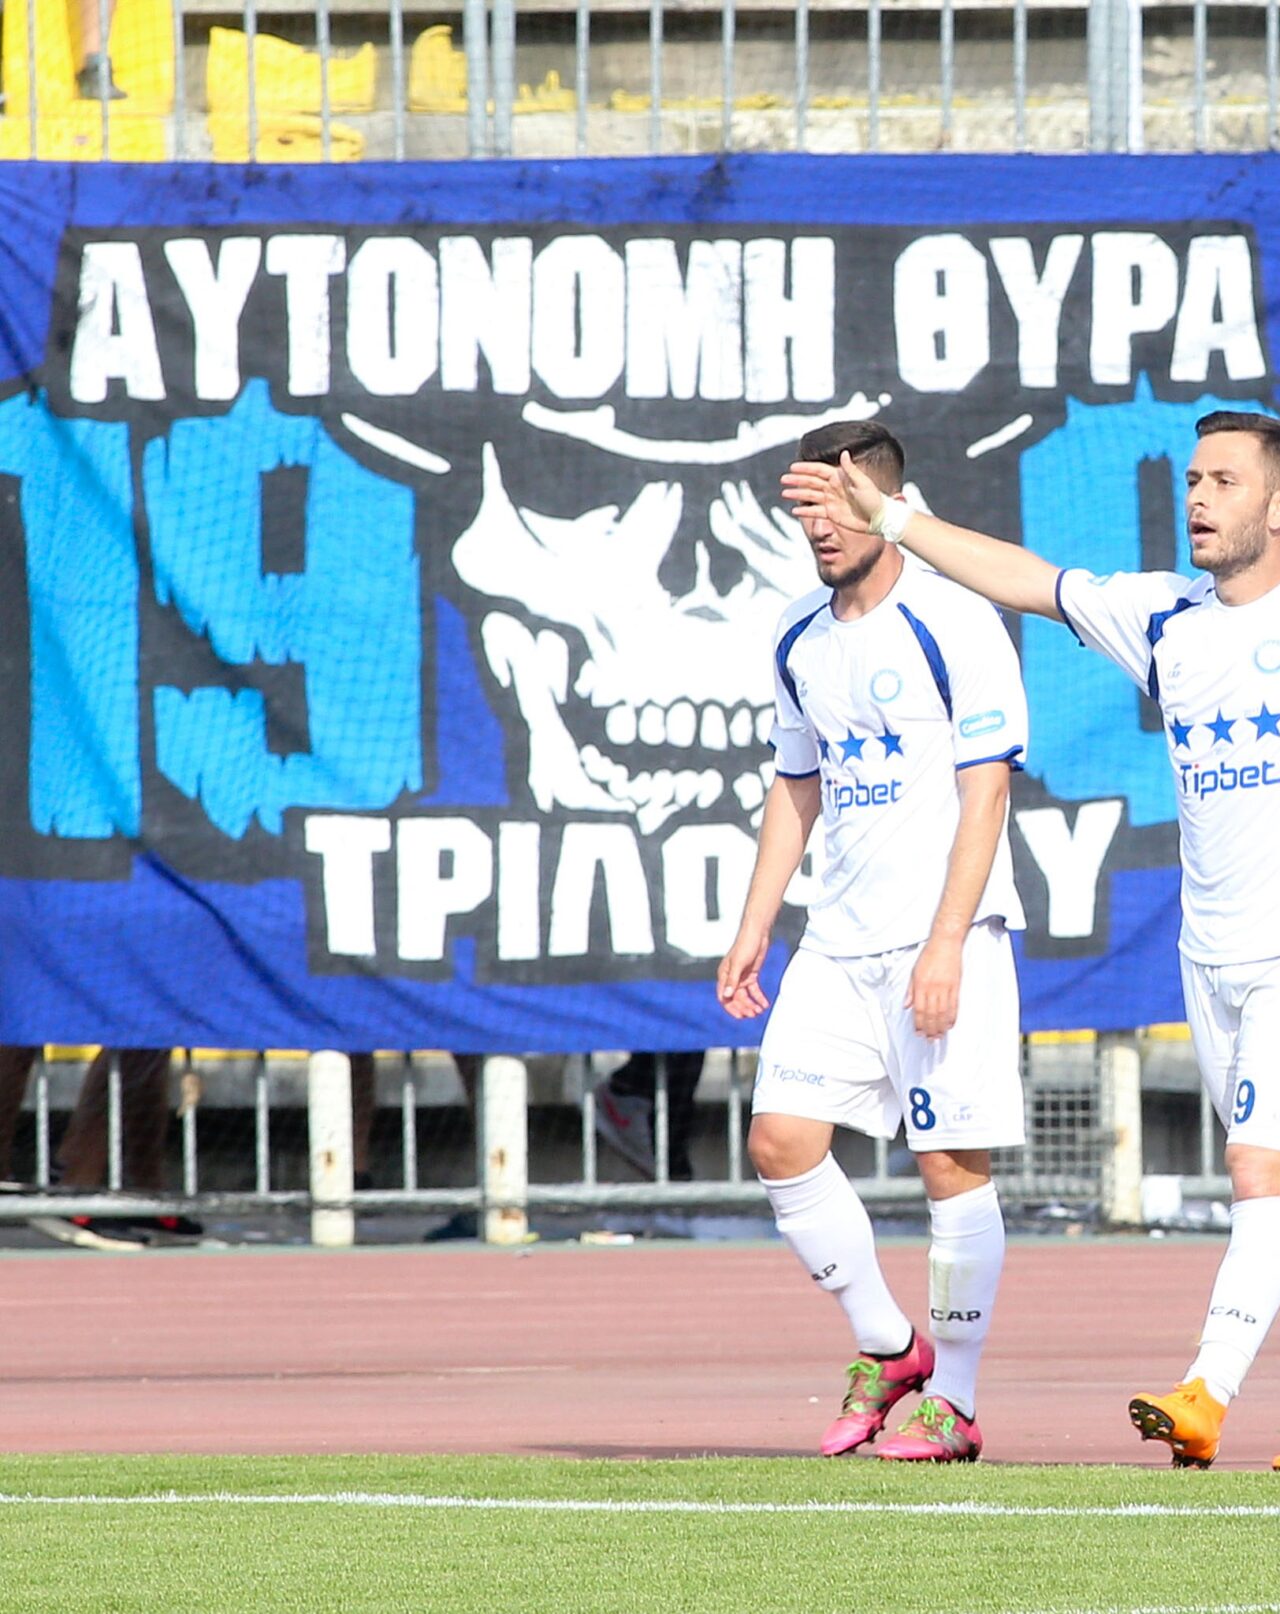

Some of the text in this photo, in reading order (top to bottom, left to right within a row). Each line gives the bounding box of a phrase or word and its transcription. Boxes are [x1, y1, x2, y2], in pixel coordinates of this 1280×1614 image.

[70, 234, 836, 403] ΑΥΤΟΝΟΜΗ
[893, 232, 1267, 388] ΘΥΡΑ
[772, 1064, 826, 1088] Tipbet
[909, 1086, 936, 1131] 8
[1233, 1079, 1256, 1124] 9
[811, 1262, 838, 1282] AP
[930, 1308, 982, 1322] CAP
[1209, 1305, 1257, 1324] CAP
